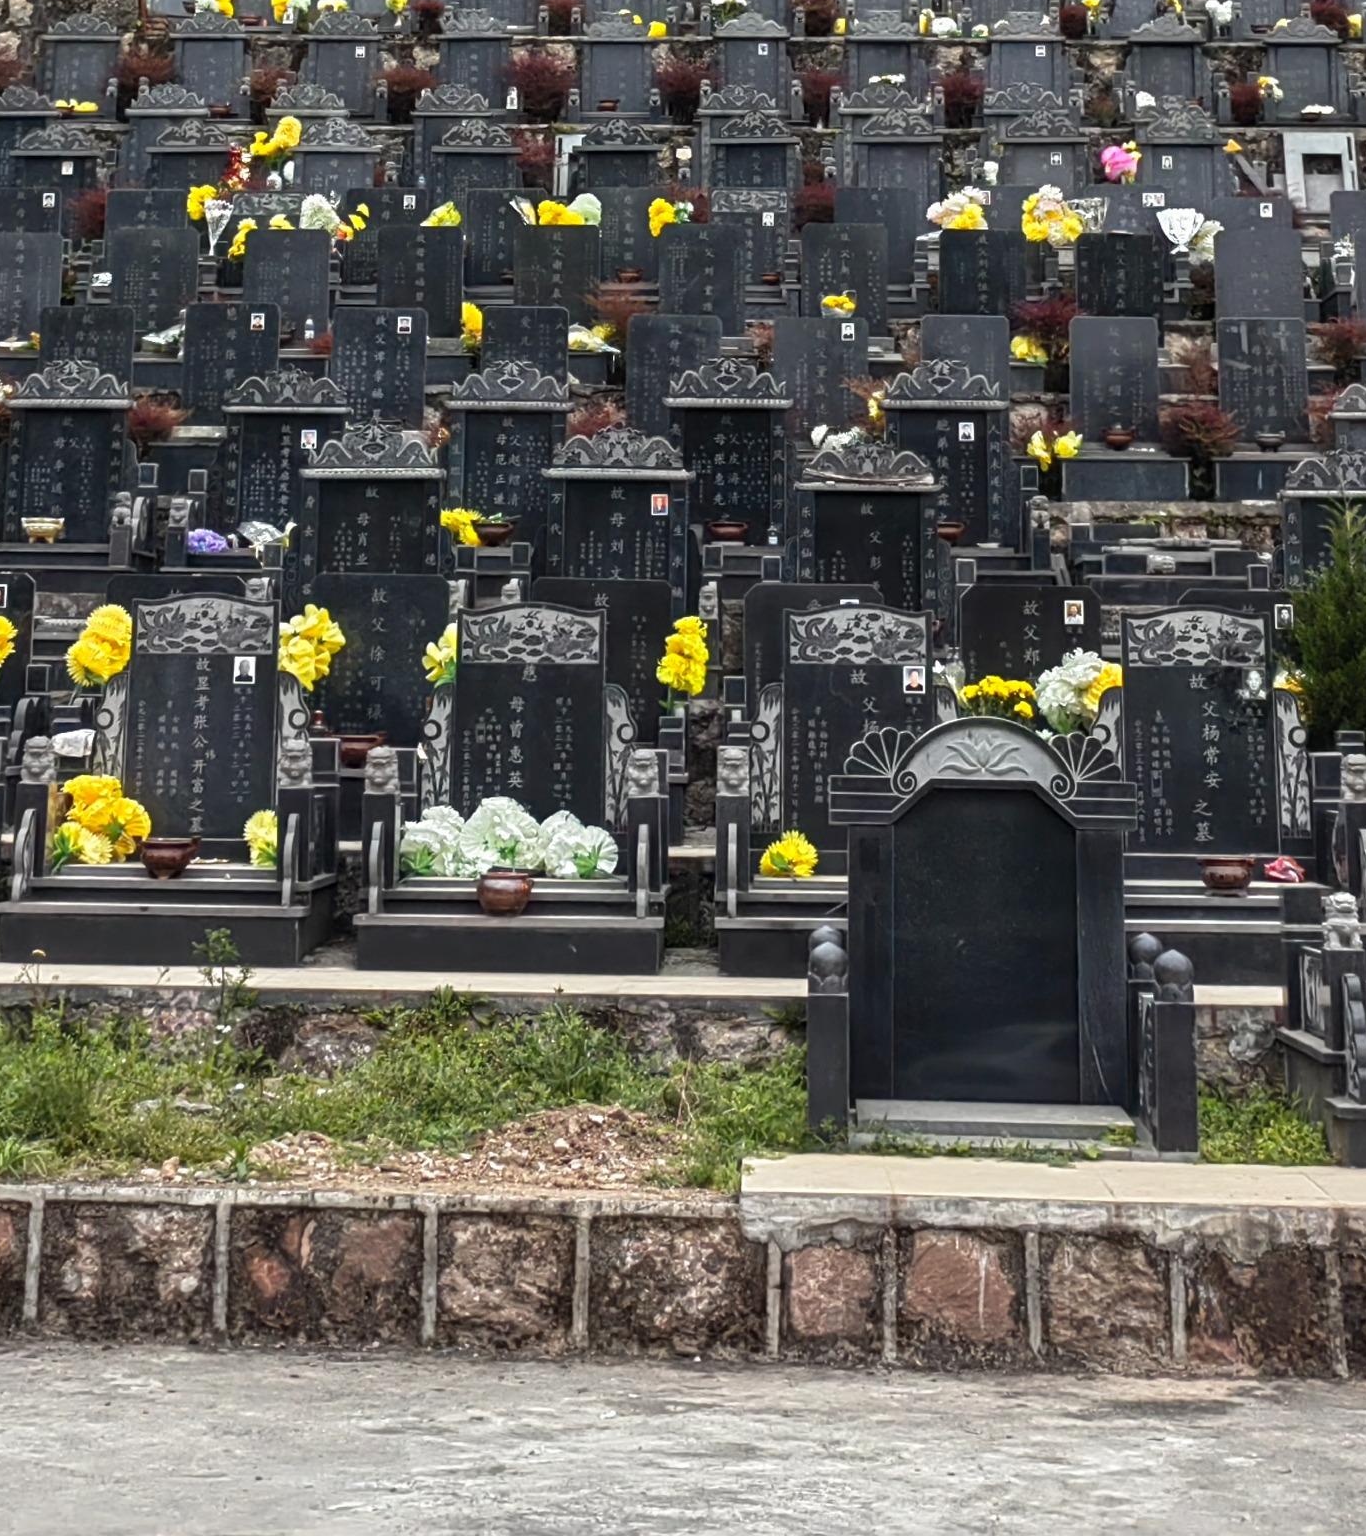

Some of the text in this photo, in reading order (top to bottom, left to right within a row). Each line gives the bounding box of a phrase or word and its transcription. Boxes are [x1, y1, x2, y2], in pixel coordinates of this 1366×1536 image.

[594, 592, 610, 608] 故
[1022, 599, 1041, 679] 故父郑
[1188, 673, 1223, 843] 故父杨常安之墓
